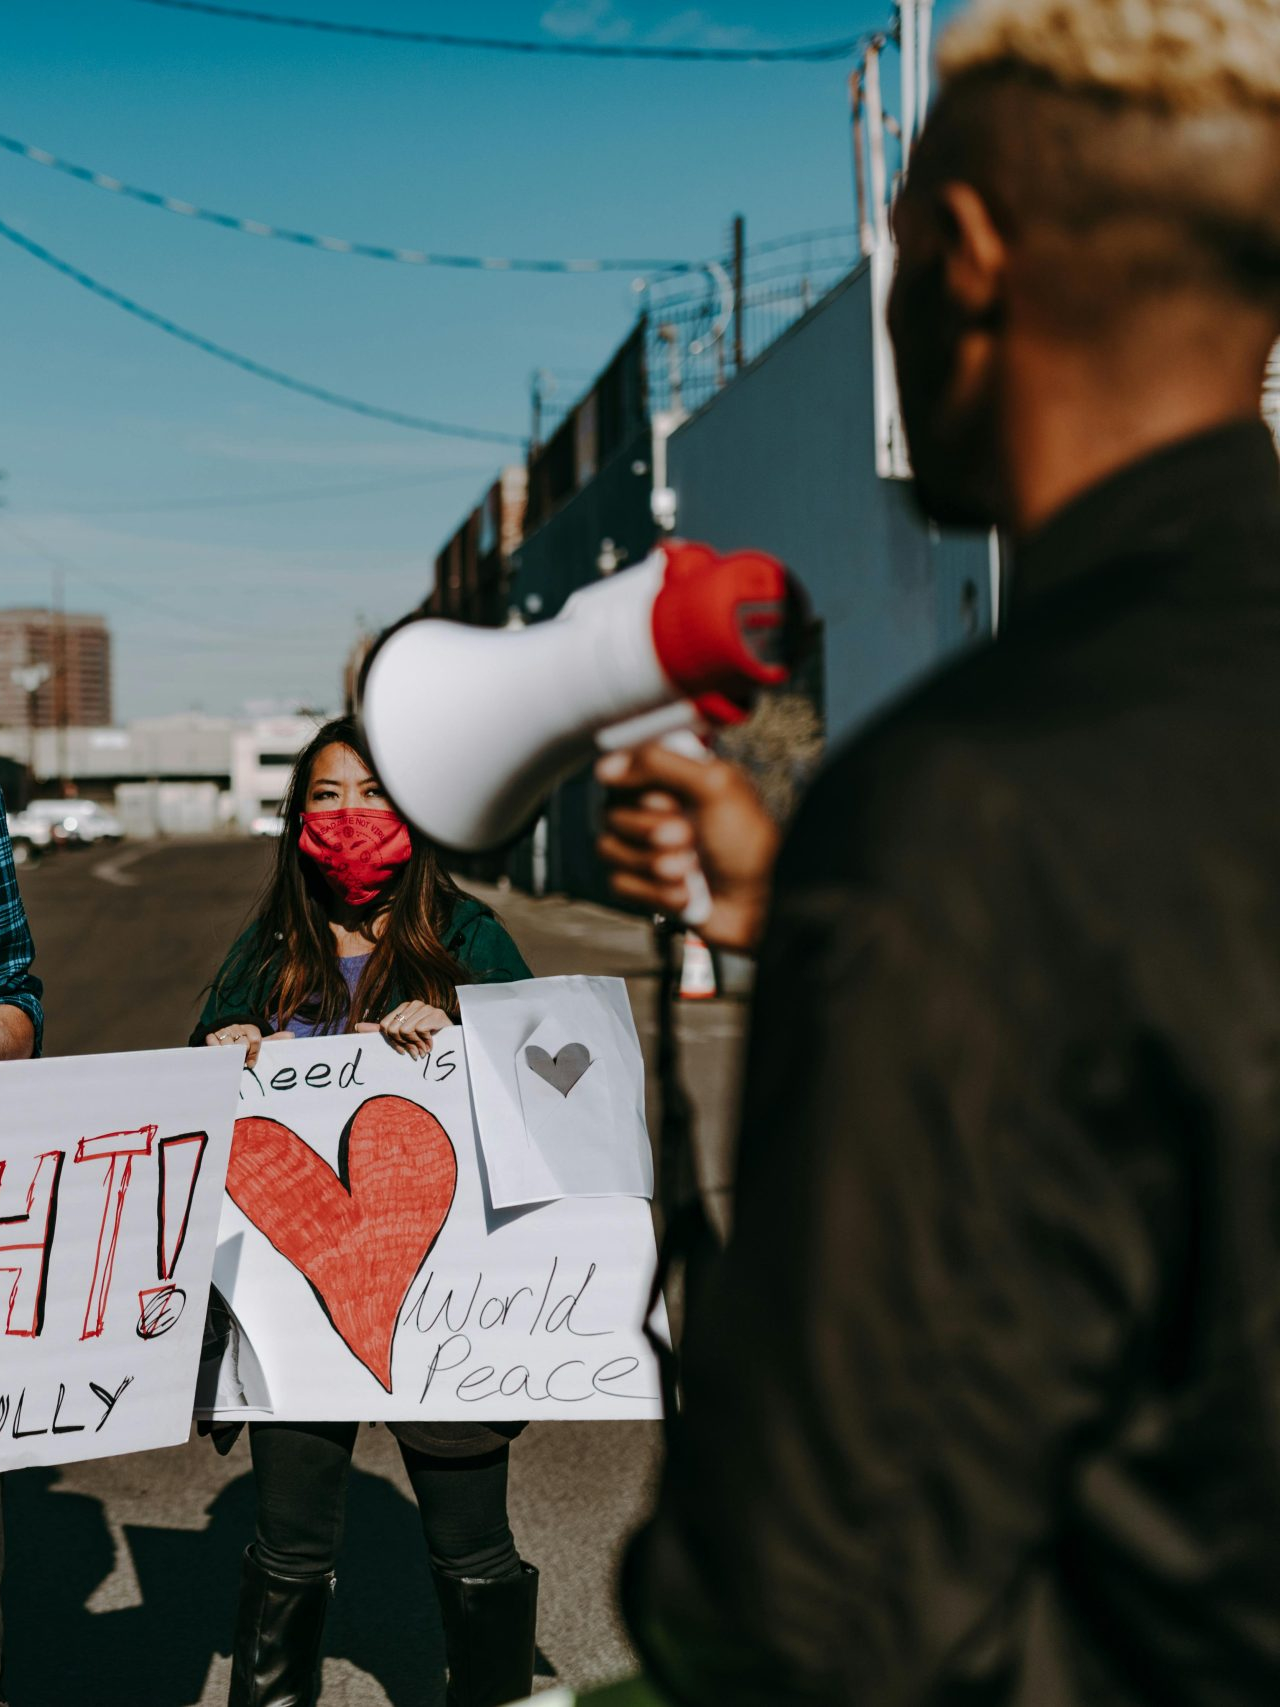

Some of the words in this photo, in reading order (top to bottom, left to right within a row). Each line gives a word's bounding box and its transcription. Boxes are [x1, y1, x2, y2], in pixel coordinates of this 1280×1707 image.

[355, 817, 370, 828] NOT
[404, 1256, 615, 1336] World
[419, 1334, 660, 1404] Peace
